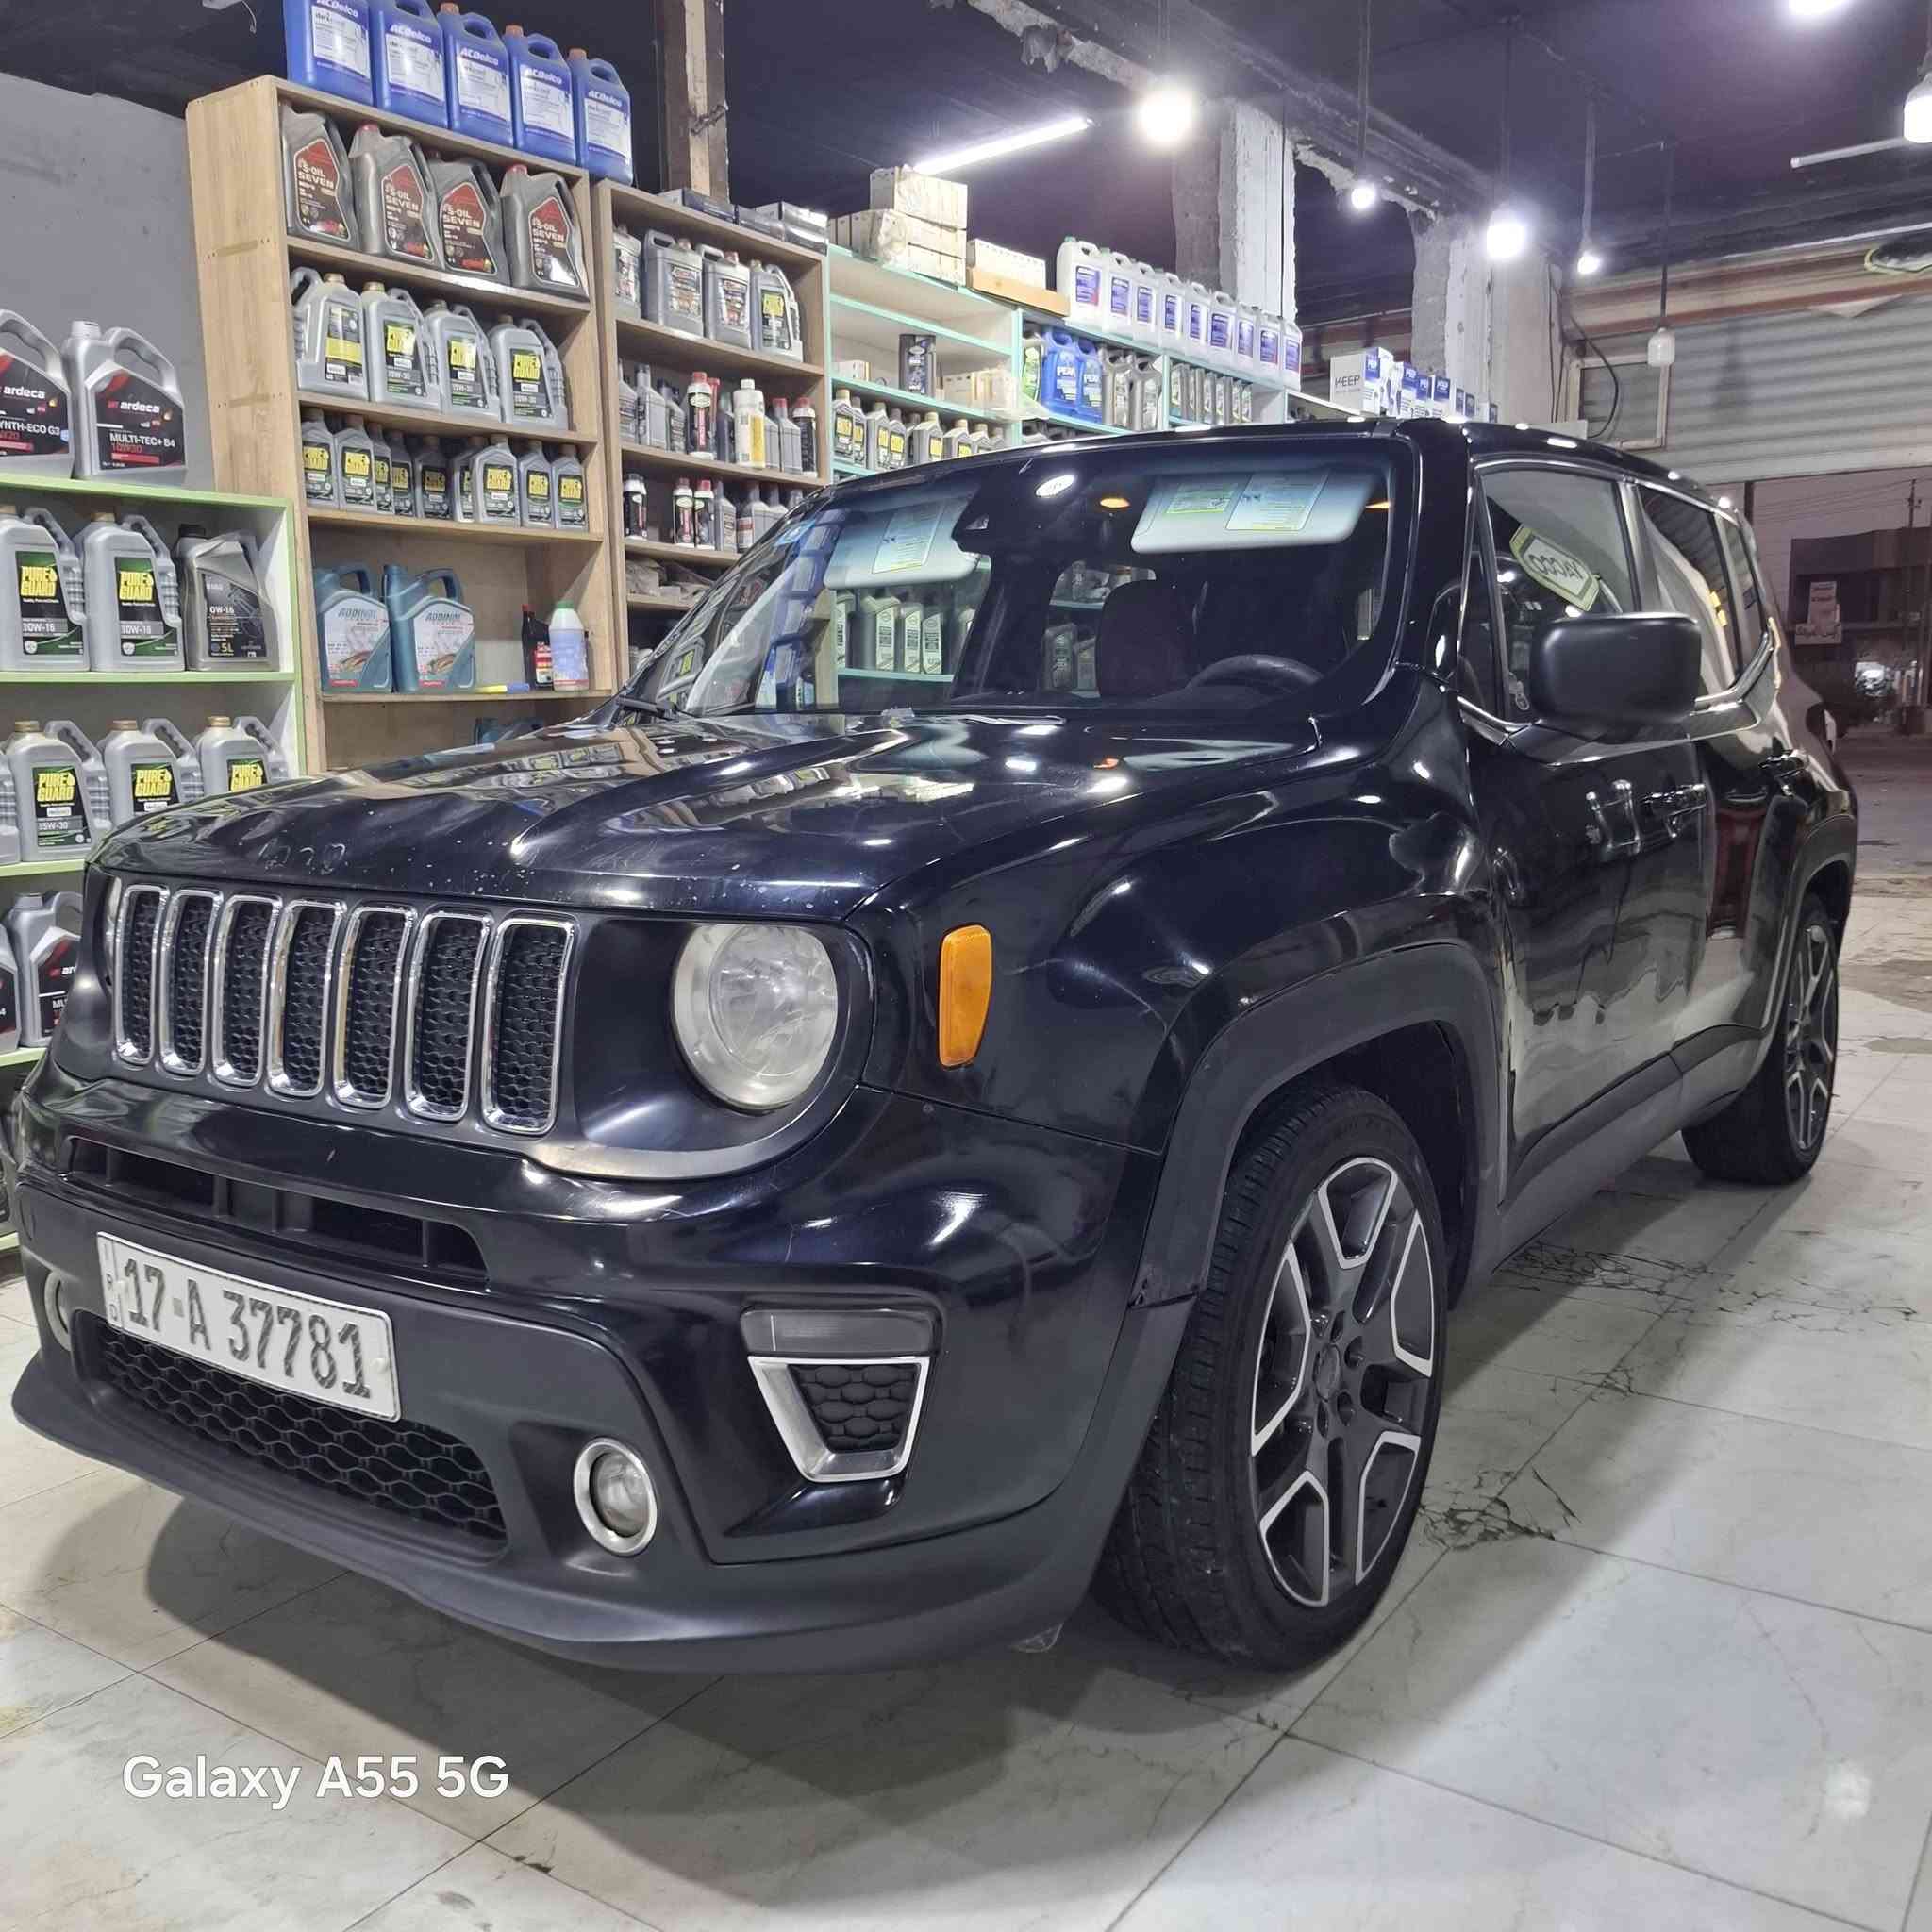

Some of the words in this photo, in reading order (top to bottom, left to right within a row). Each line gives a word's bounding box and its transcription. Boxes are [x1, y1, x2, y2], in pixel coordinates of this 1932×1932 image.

[4, 386, 45, 399] ardeca
[120, 400, 160, 413] ardeca
[124, 1257, 165, 1333] 17
[188, 1278, 211, 1351] A
[223, 1289, 371, 1399] 37781
